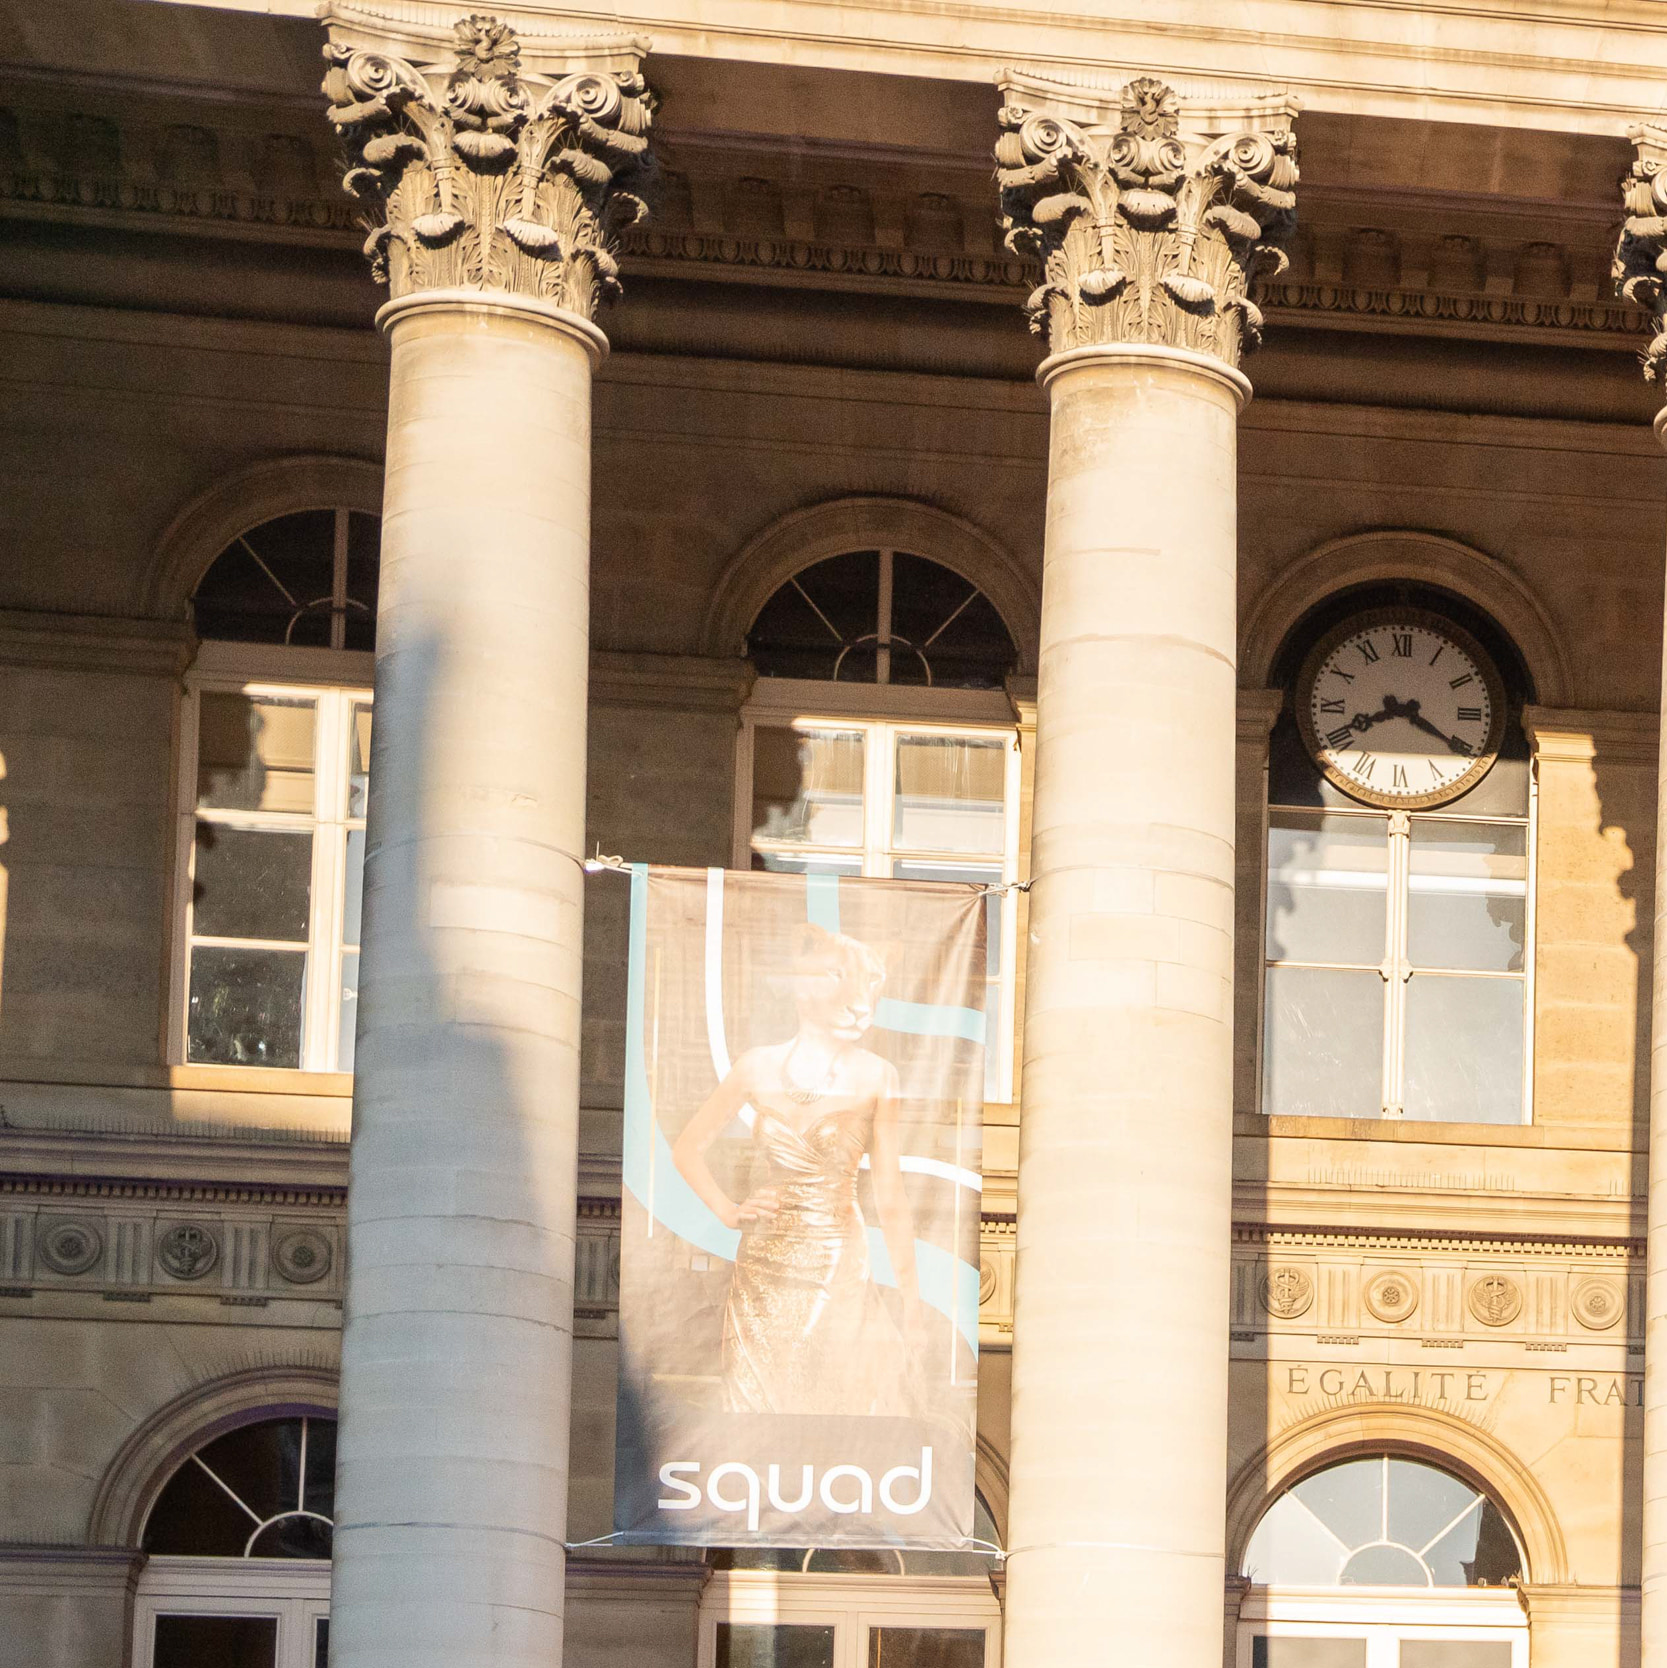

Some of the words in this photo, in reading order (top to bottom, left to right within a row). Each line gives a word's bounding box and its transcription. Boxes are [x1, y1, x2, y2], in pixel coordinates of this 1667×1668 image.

[1356, 639, 1381, 666] XI
[1391, 633, 1413, 658] XII
[1330, 664, 1355, 685] X
[1320, 698, 1345, 715] IX
[1457, 706, 1482, 722] III
[1352, 751, 1377, 780] VII
[1392, 764, 1409, 788] VI
[1287, 1365, 1489, 1401] ÉGALITÉ
[658, 1446, 932, 1531] squad
